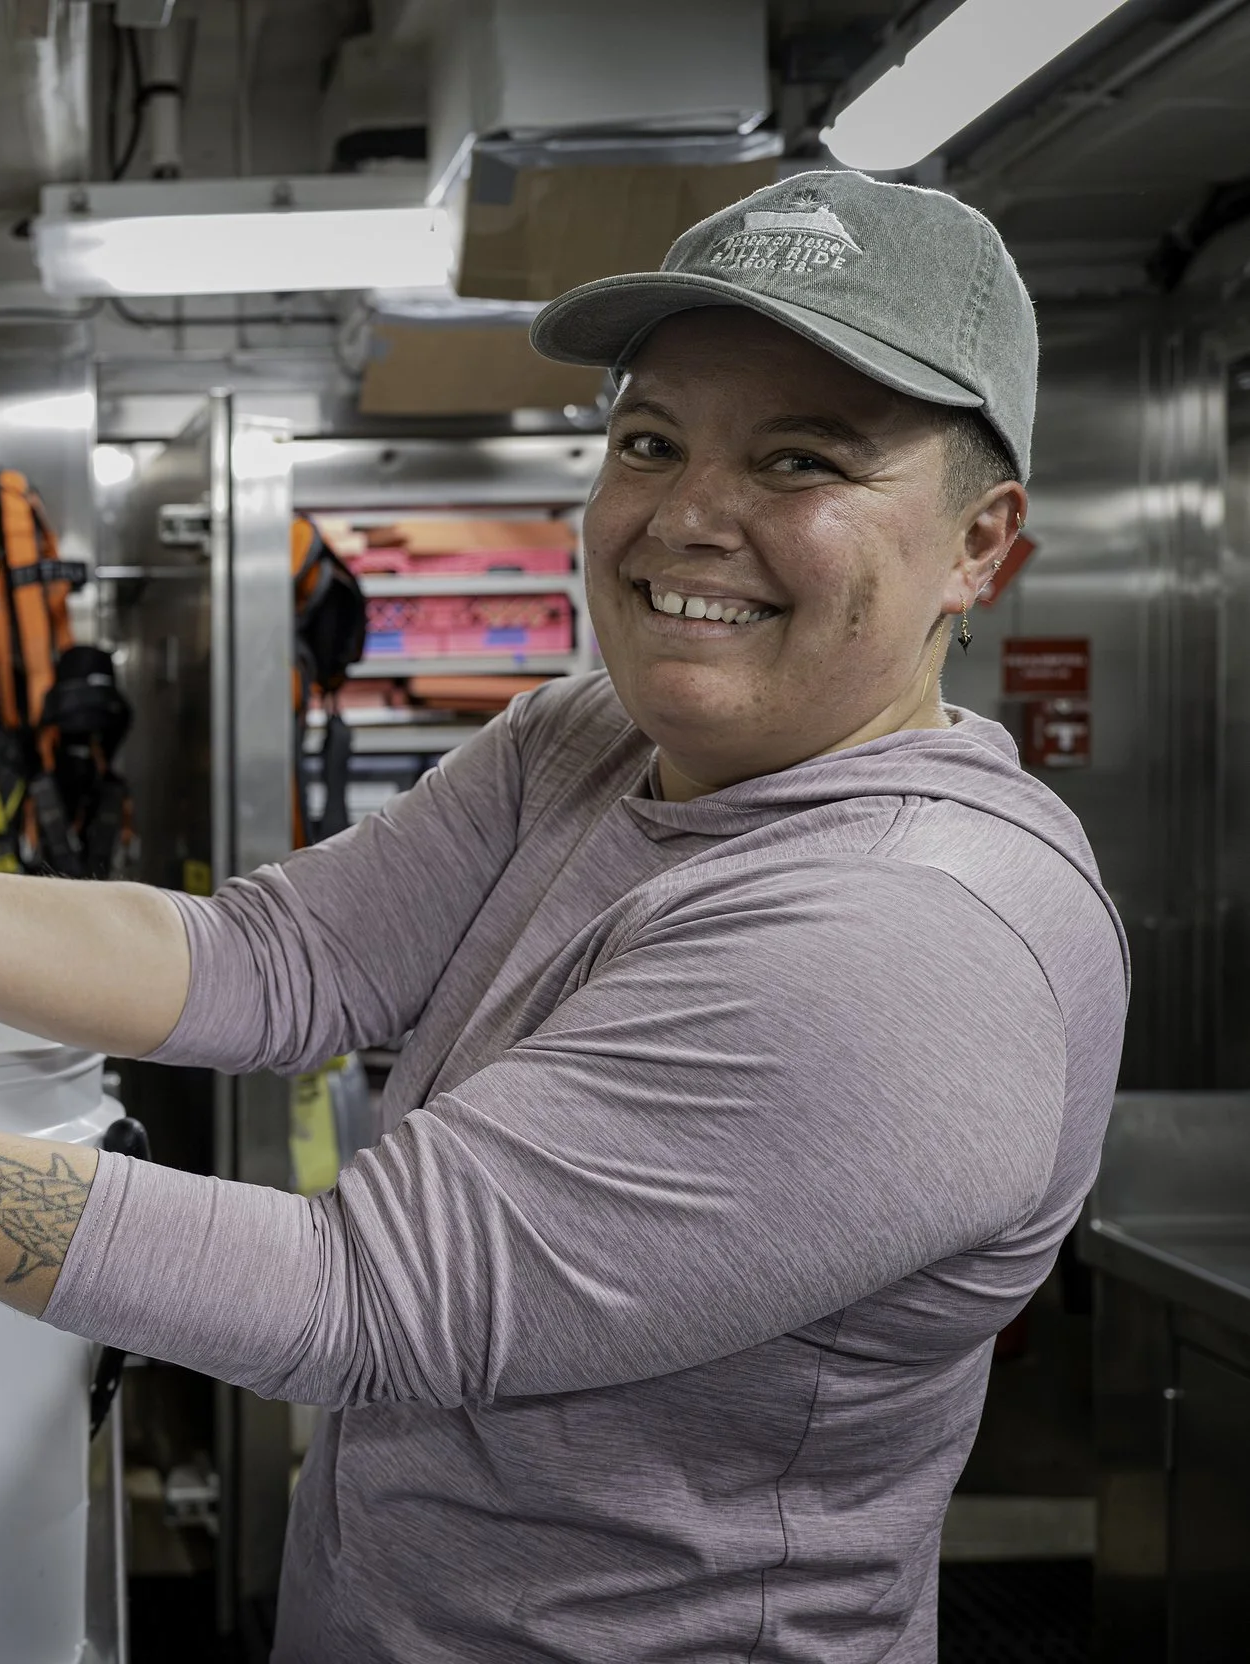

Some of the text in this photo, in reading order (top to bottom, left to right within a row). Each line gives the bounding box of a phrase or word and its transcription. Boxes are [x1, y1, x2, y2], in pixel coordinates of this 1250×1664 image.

[724, 234, 846, 256] Research Vessel
[710, 246, 846, 270] SALLY RIDE
